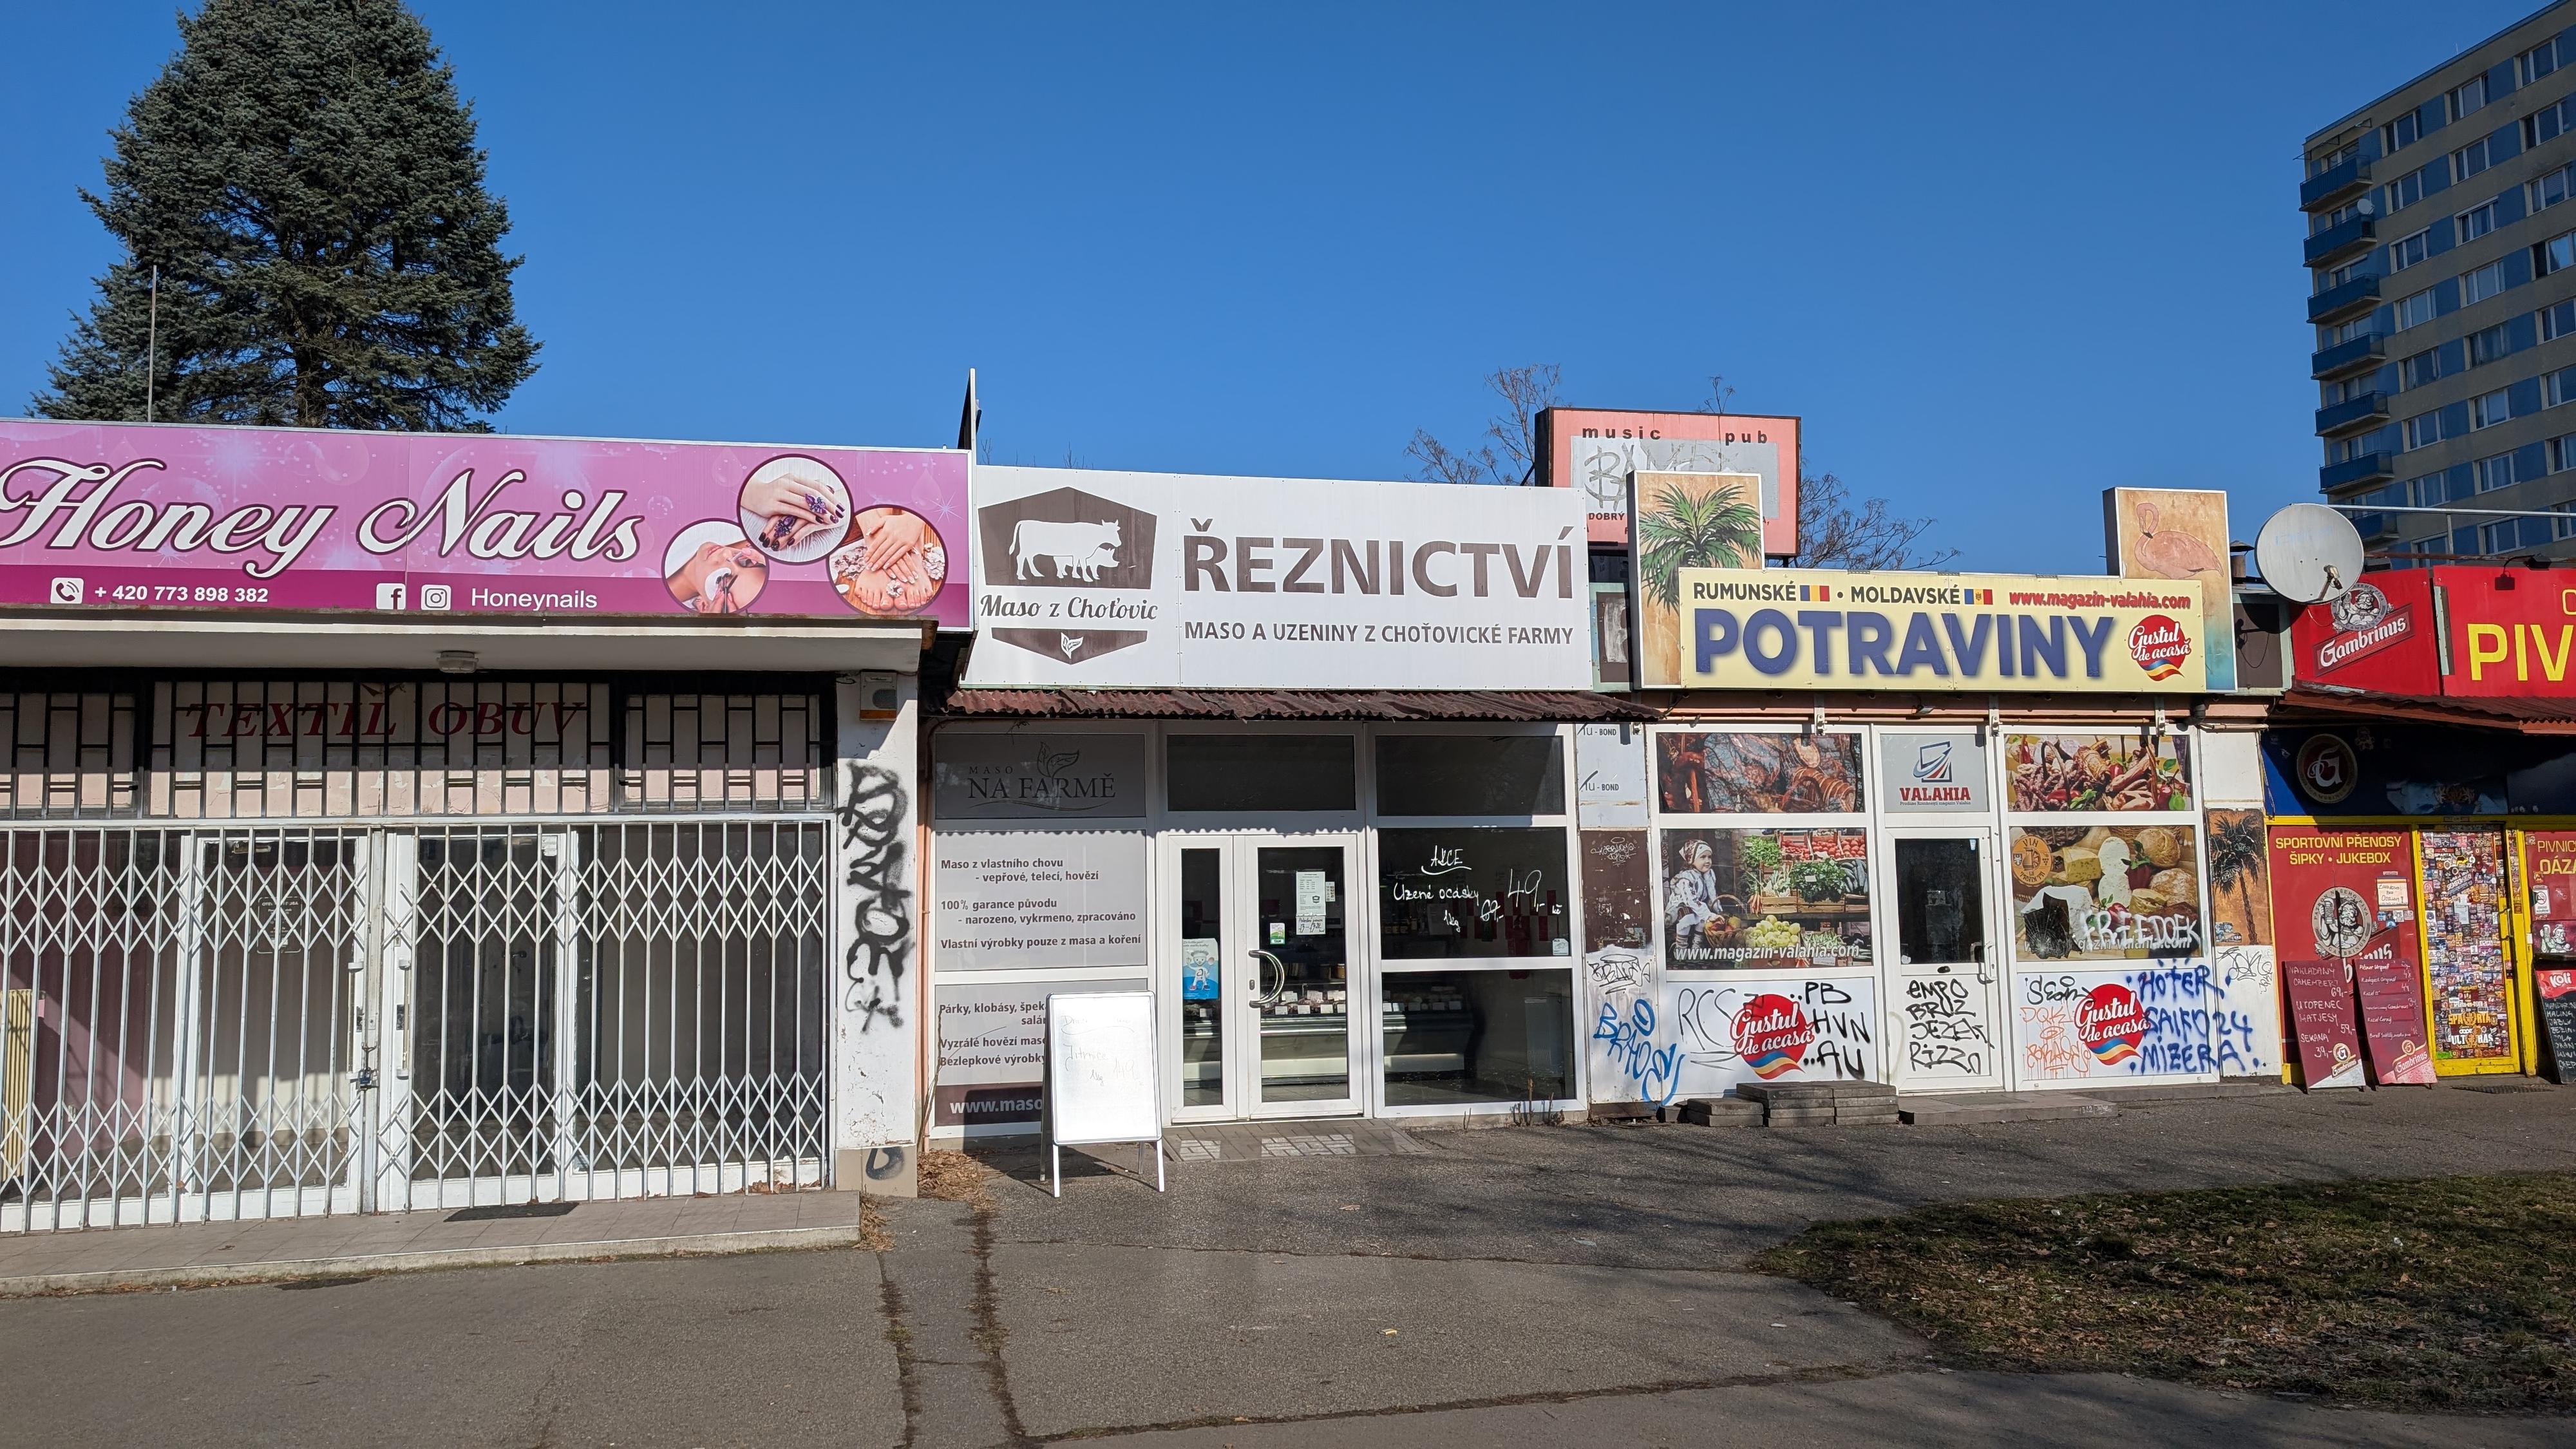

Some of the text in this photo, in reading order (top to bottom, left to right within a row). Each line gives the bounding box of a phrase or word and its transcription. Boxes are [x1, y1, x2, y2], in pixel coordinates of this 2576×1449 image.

[1582, 426, 1768, 446] music pub
[0, 457, 644, 579] Honey Nails
[1588, 511, 1625, 520] DOBRÝ
[1184, 517, 1573, 600] ŘEZNICTVÍ
[112, 585, 147, 601] 420
[154, 586, 188, 601] 773
[194, 587, 229, 601] 898
[234, 587, 269, 603] 382
[471, 587, 598, 610] Honeynails
[1693, 580, 2191, 609] RUMUNSKÉ MOLDAVSKÉ www.magazin-valahia.com
[980, 594, 1159, 622] Maso z Choťovic
[1185, 621, 1573, 646] MASO A UZENINY Z CHOŤOVICKÉ FARMY
[1695, 607, 2114, 679] POTRAVINY
[2129, 622, 2180, 659] Gustul
[2320, 617, 2407, 667] Gambrinus
[2139, 640, 2190, 661] de acasă
[2468, 623, 2574, 682] PIV
[186, 701, 587, 737] TEXTIL OBUV
[969, 765, 1014, 775] MASO
[967, 773, 1117, 799] NA FARMĚ
[1899, 787, 1971, 800] VALAHIA
[2275, 834, 2401, 849] SPORTOVNÍ PŘENOSY
[2537, 840, 2576, 853] PIVNIC
[941, 859, 969, 869] Maso
[980, 858, 1030, 869] vlastního
[1032, 858, 1064, 868] chovu
[1430, 845, 1464, 867] AKCE
[2289, 851, 2391, 865] ŠIPKY JUKEBOX
[982, 871, 1028, 885] vepřové,
[1030, 871, 1063, 882] telecí,
[1065, 870, 1099, 881] hovězí
[1393, 882, 1479, 906] Uzené ocásky
[941, 898, 1057, 912] 100% garance původu
[965, 914, 1018, 925] narozeno,
[1019, 913, 1074, 925] vykrmeno,
[1077, 912, 1136, 923] zpracováno
[941, 938, 978, 949] Vlastní
[980, 937, 1024, 950] výrobky
[1027, 937, 1058, 949] pouze
[1069, 937, 1096, 945] masa
[1108, 934, 1142, 945] koření
[1675, 943, 1860, 962] www.magazin-valahia.com
[2549, 972, 2572, 988] Koli
[939, 1001, 1046, 1015] Párky, klobásy, špek
[2077, 990, 2137, 1039] Gustul
[1732, 1002, 1799, 1050] Gustul
[2087, 1012, 2150, 1043] de acasă
[940, 1037, 980, 1049] Vyzrálé
[983, 1036, 1018, 1047] hovězí
[1743, 1023, 1814, 1056] de acasă
[940, 1055, 1001, 1066] Bezlepkové
[2396, 1050, 2428, 1073] Gambrinus
